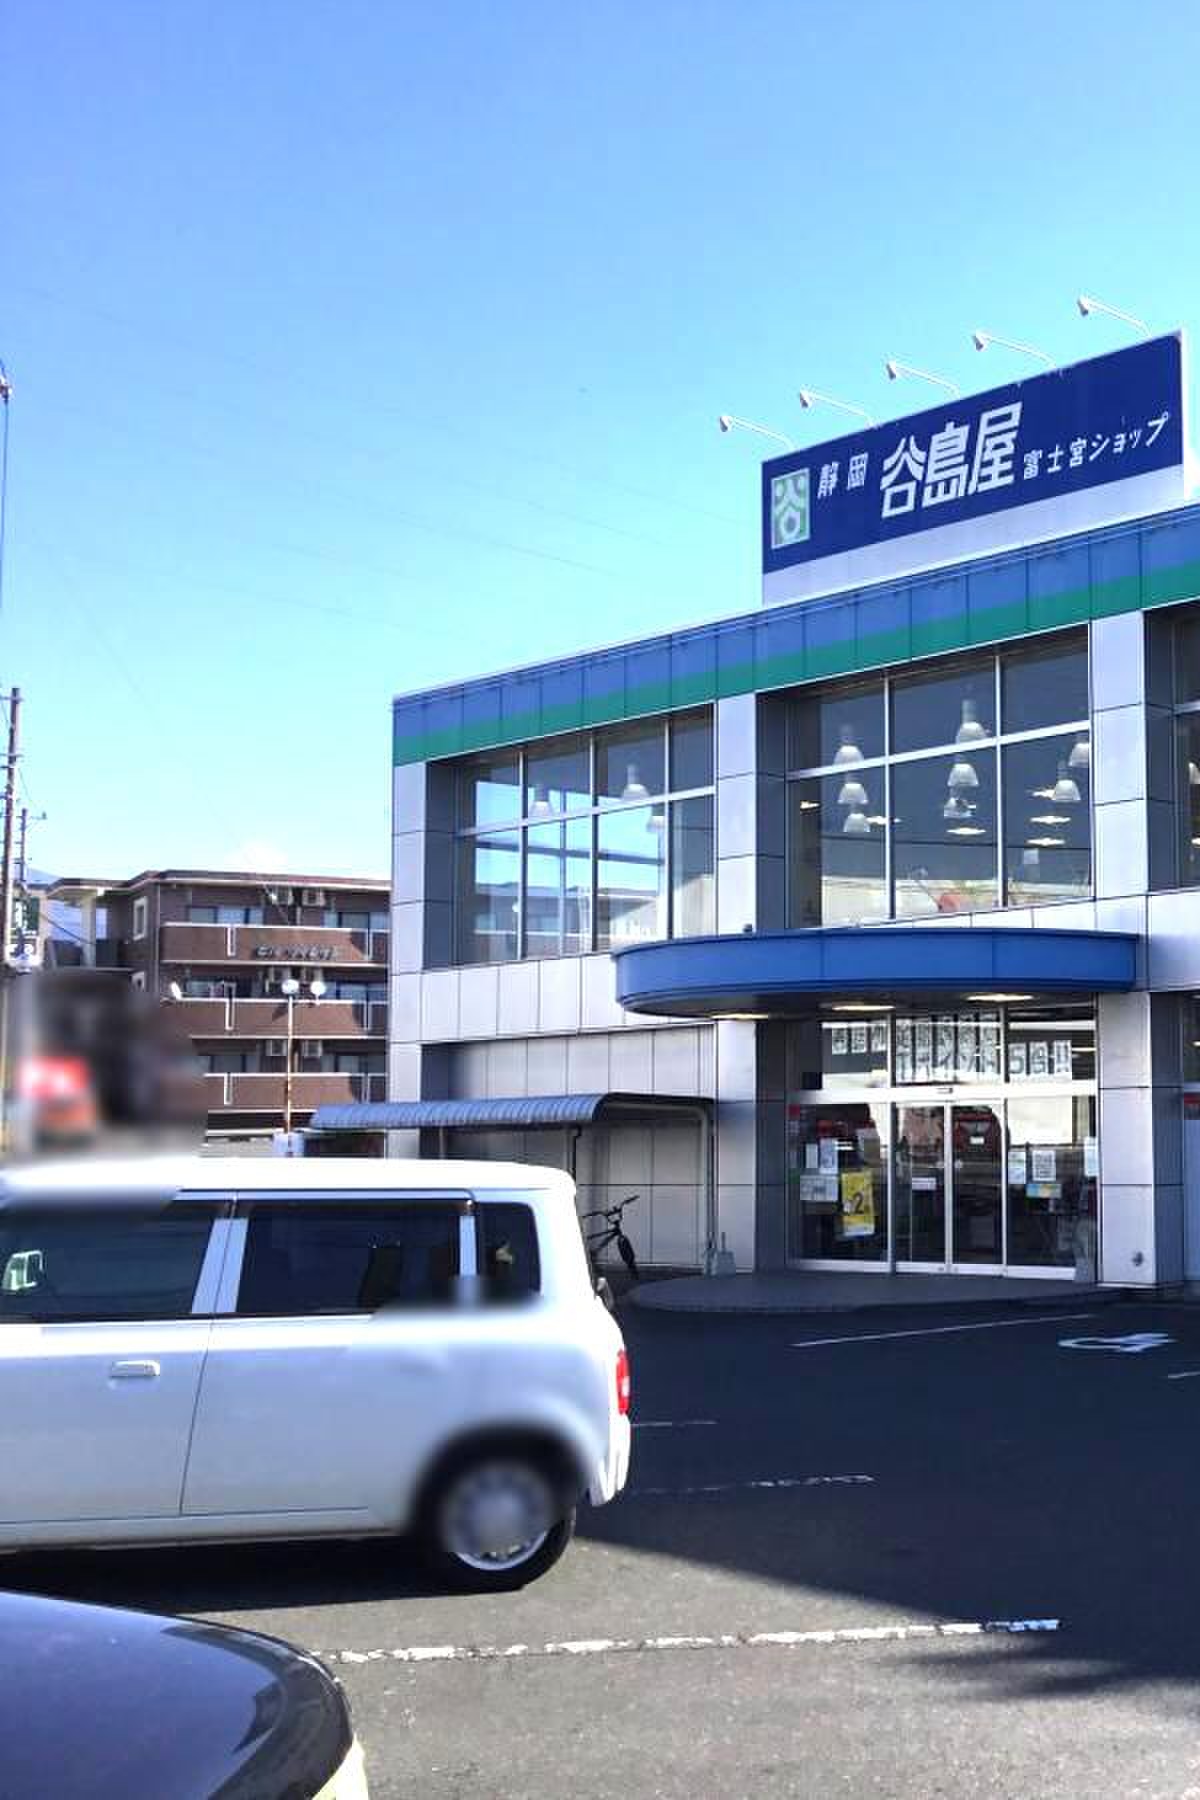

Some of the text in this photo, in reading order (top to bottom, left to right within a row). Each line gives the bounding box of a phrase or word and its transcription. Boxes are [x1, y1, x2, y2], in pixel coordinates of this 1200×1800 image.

[817, 402, 1170, 519] 静岡 谷島屋 富士宮ショップ
